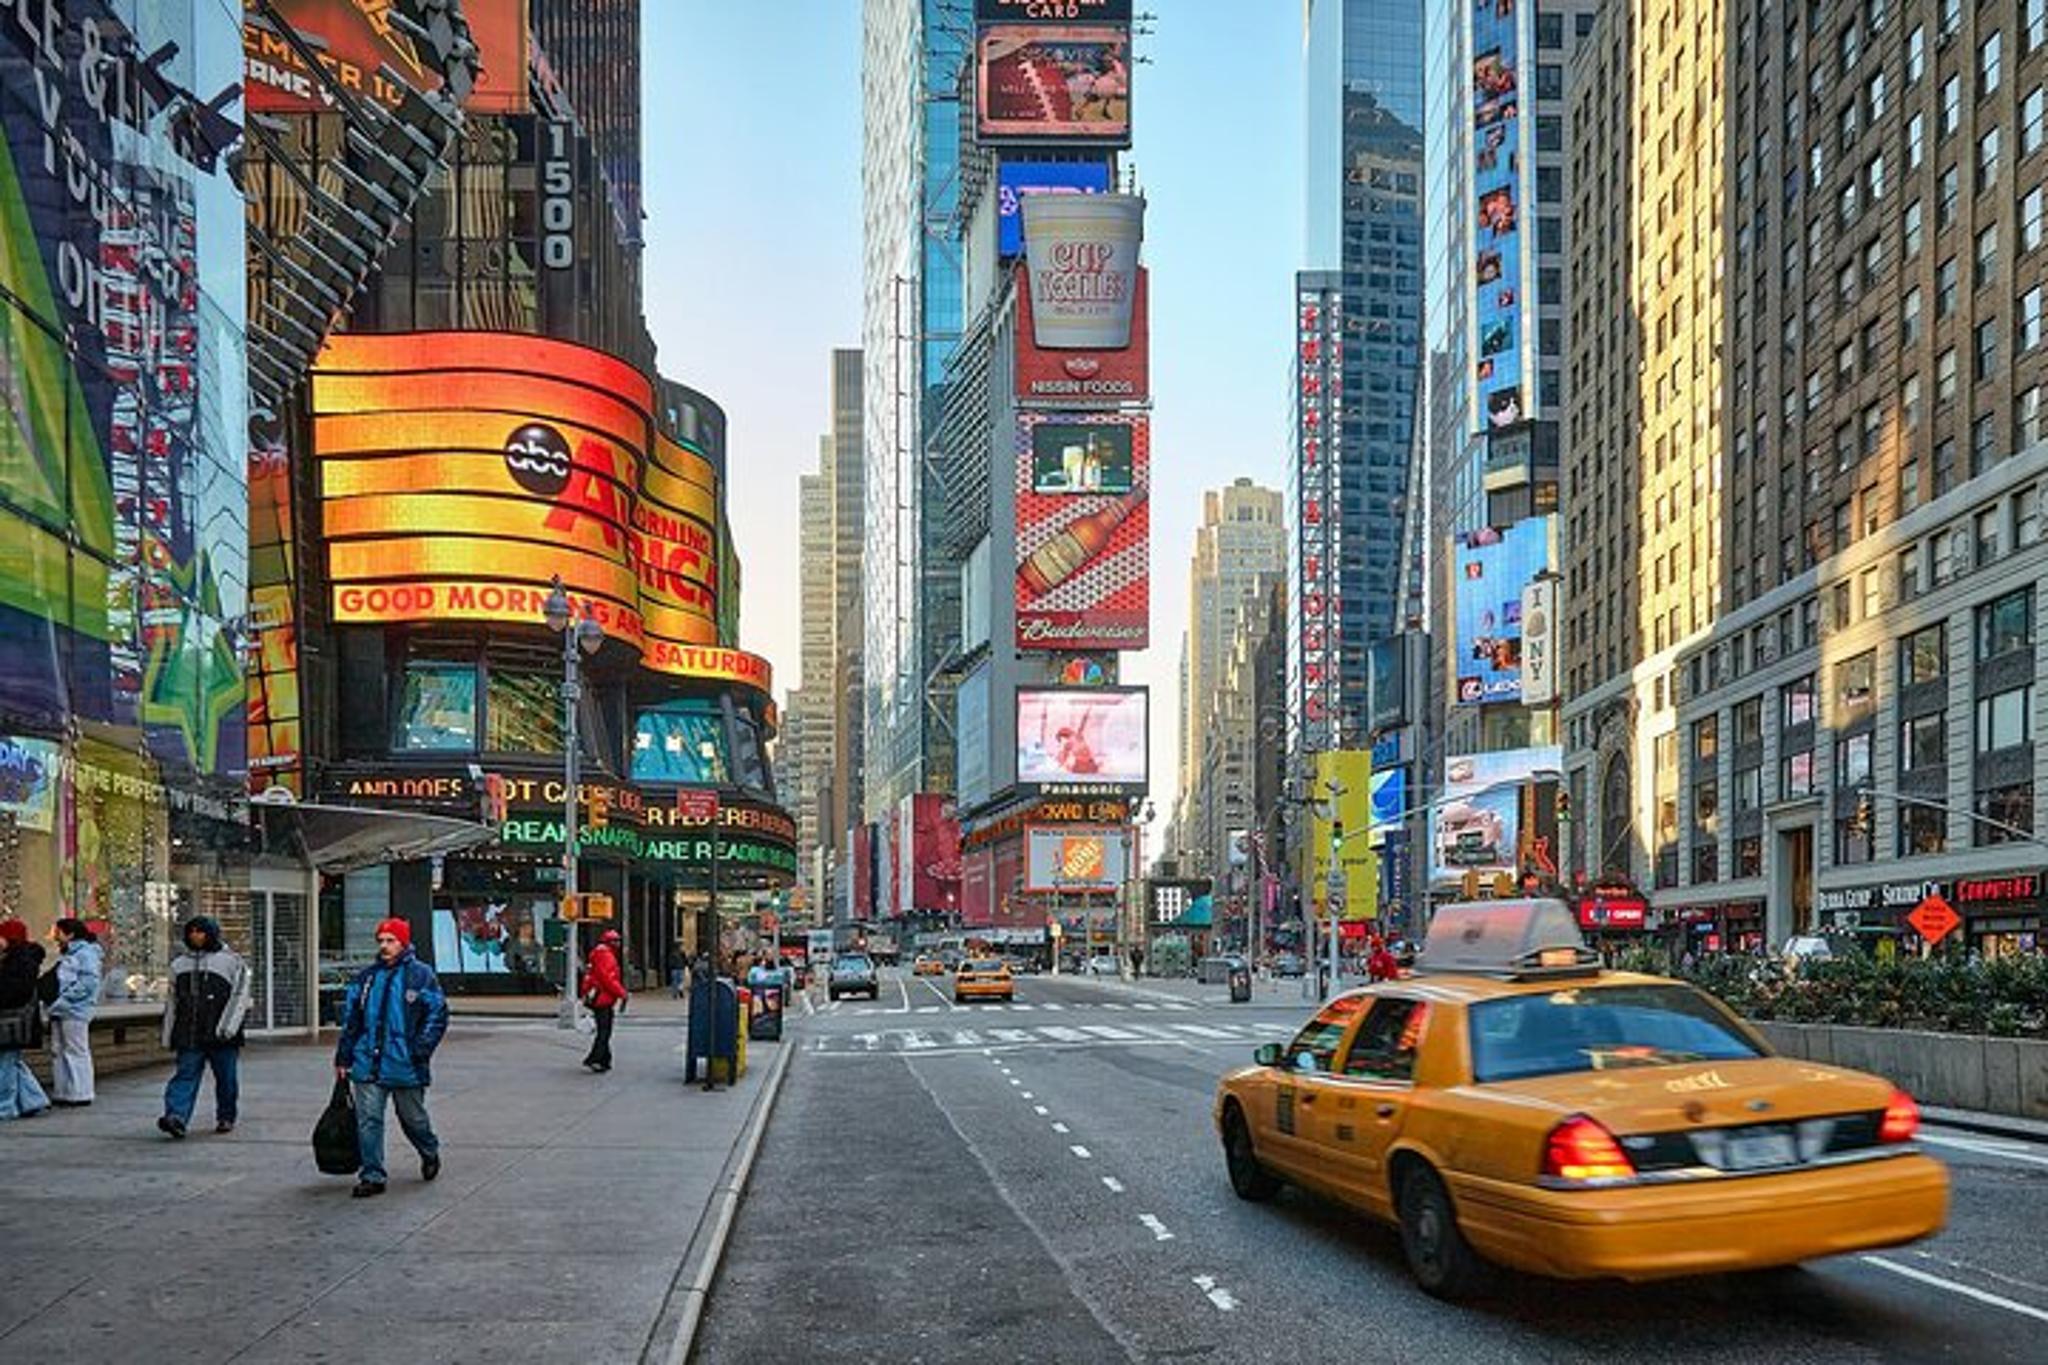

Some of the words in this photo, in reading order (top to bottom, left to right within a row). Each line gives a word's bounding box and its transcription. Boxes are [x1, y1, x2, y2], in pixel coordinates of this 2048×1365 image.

[1026, 4, 1079, 18] CARD
[543, 125, 572, 269] 1500
[1052, 241, 1113, 273] CUP
[1031, 379, 1080, 394] NISSIN
[1083, 379, 1134, 394] FOODS
[507, 440, 569, 476] abc
[340, 588, 434, 613] GOOD
[447, 586, 610, 625] MORNNG
[1018, 618, 1145, 641] Budweiser
[1040, 784, 1124, 795] Panasonic
[646, 842, 689, 859] ARE
